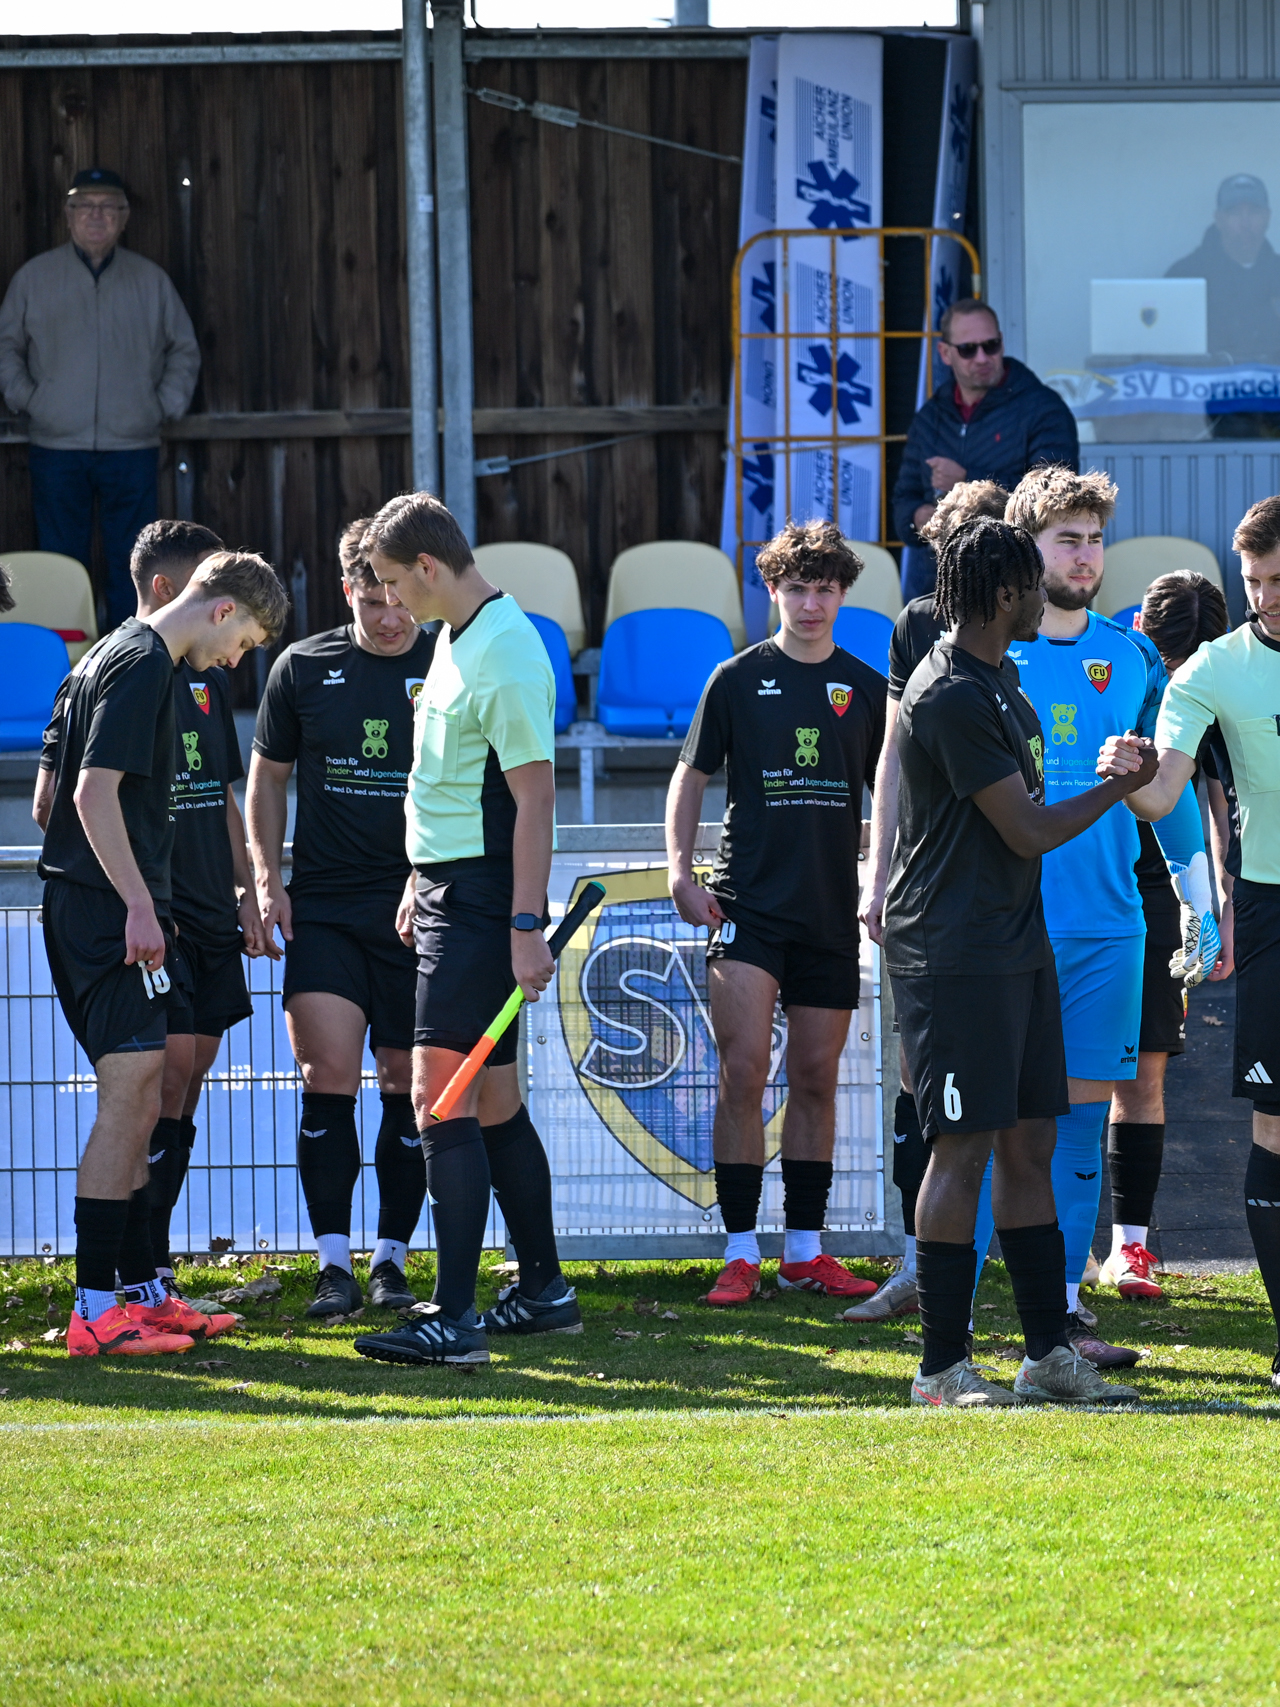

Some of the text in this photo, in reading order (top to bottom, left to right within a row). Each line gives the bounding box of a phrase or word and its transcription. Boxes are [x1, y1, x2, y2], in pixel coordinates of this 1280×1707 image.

[814, 84, 826, 141] AICHER
[826, 87, 839, 170] AMBULANZ
[841, 92, 853, 140] UNION
[815, 269, 827, 325] AICHER
[843, 277, 855, 325] UNION
[1123, 373, 1158, 397] SV
[815, 450, 827, 506] AICHER
[841, 459, 853, 506] UNION
[348, 757, 358, 766] für
[354, 768, 369, 777] und
[783, 768, 793, 776] für
[789, 777, 804, 786] und
[1046, 757, 1059, 766] und
[943, 1072, 963, 1122] 6
